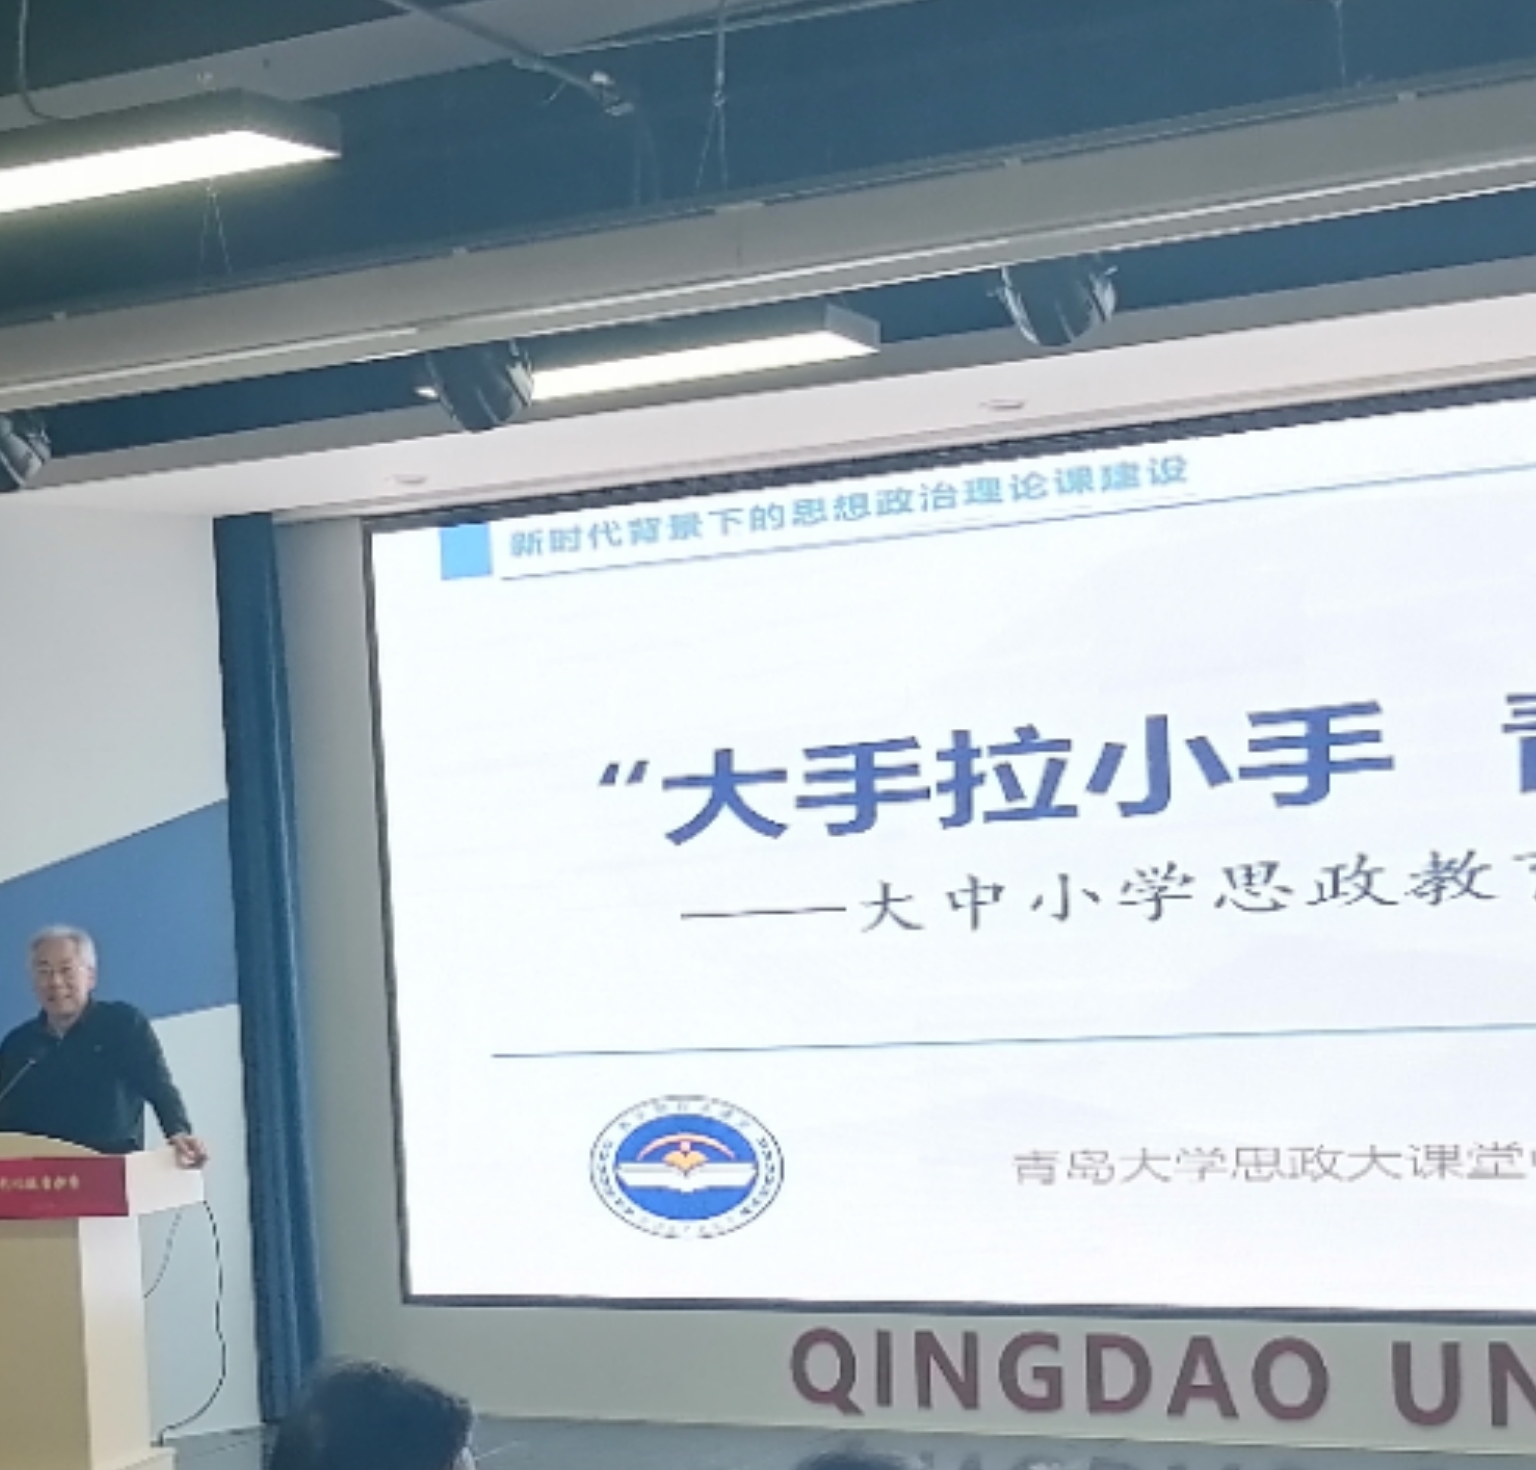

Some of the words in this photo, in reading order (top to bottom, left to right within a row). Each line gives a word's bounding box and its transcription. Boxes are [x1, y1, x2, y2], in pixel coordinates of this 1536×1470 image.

[509, 455, 1189, 558] 新时代背景下的思想政治理论课建设
[598, 700, 1395, 847] “大手拉小手
[788, 1326, 1330, 1423] QINGDAO
